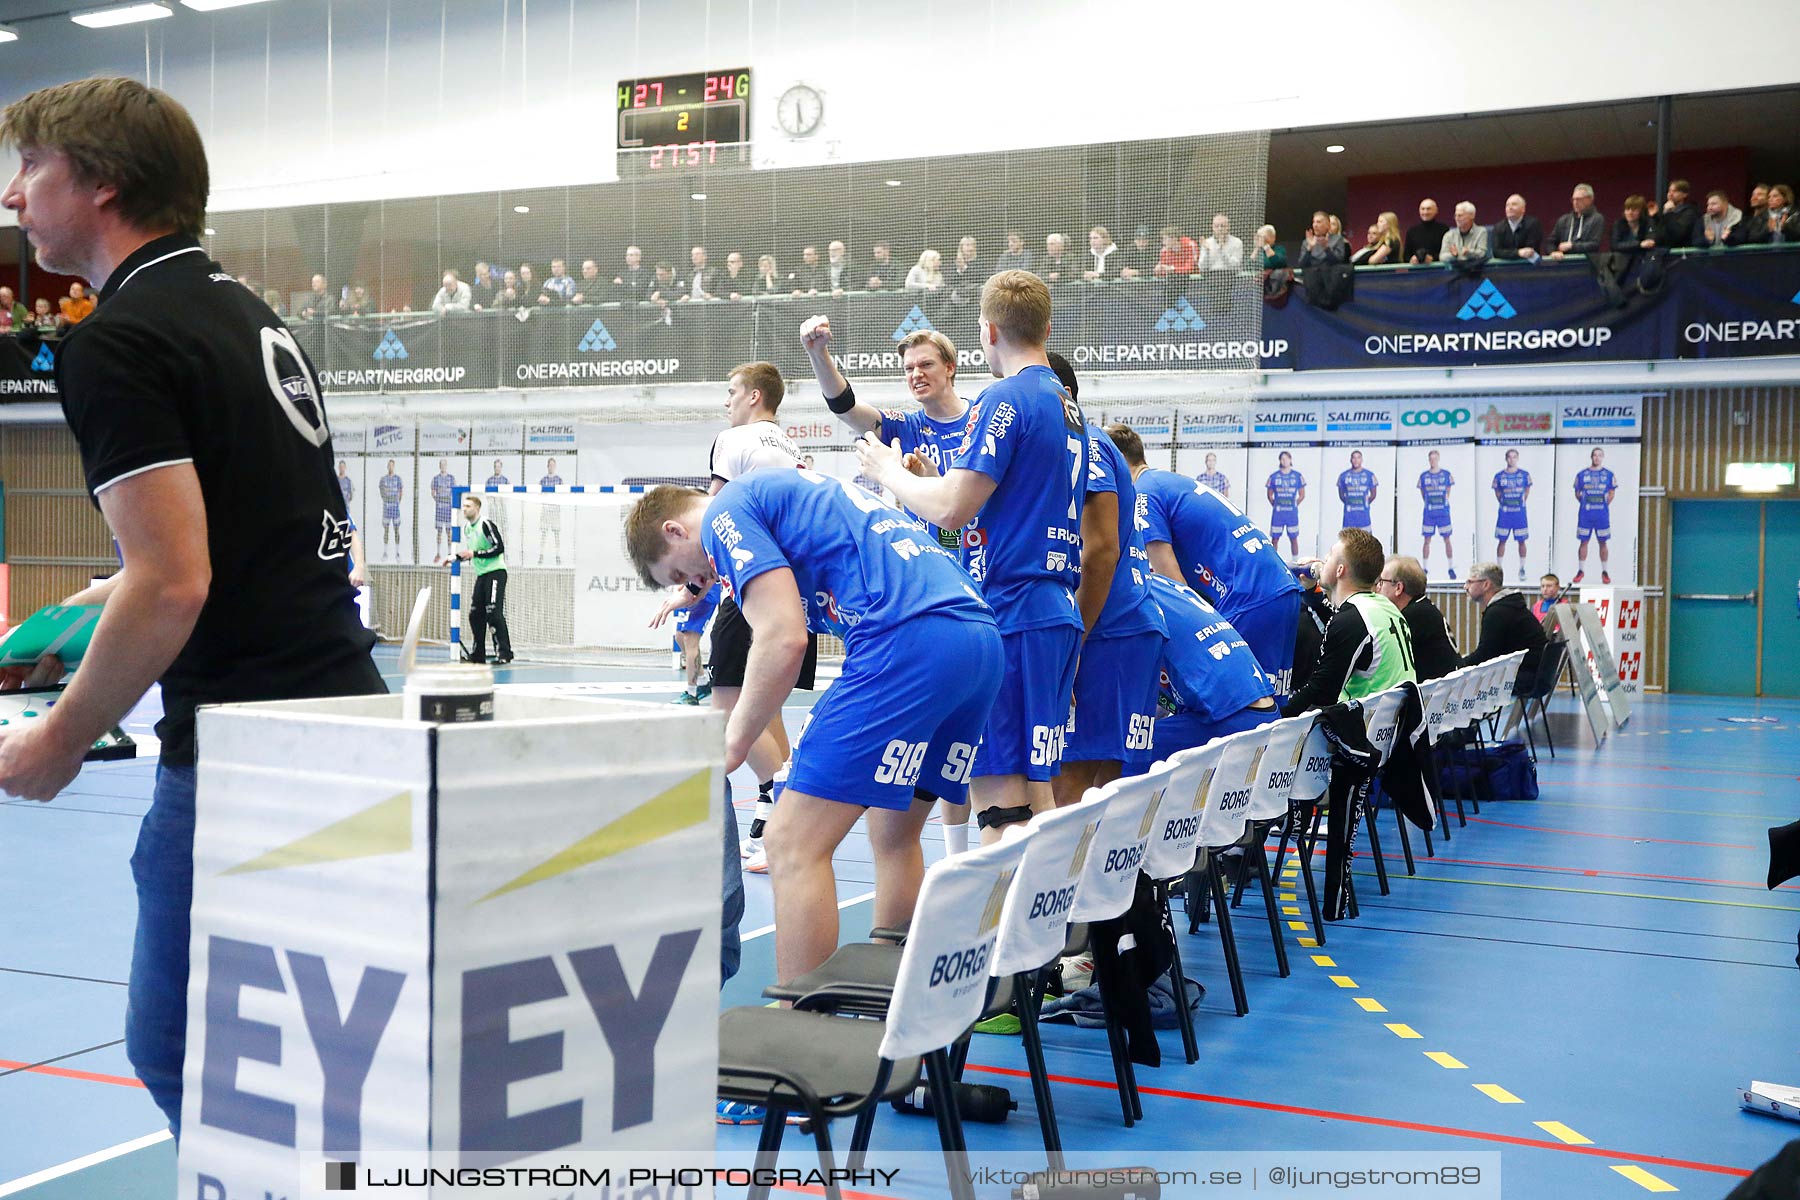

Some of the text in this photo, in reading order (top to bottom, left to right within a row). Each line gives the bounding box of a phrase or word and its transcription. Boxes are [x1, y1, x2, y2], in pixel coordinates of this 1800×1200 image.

[617, 87, 630, 108] H
[634, 83, 663, 108] 27
[704, 75, 734, 101] 24
[735, 74, 749, 97] G
[677, 112, 689, 131] 2
[1073, 340, 1289, 363] ONEPARTNERGROUP
[1365, 327, 1612, 355] ONEPARTNERGROUP
[318, 366, 465, 386] ONEPARTNERGROUP
[516, 358, 680, 379] ONEPARTNERGROUP
[987, 401, 1011, 435] INTER
[995, 405, 1017, 439] SPORT
[1254, 412, 1318, 423] SALMING
[1327, 411, 1392, 422] SALMING
[1401, 408, 1471, 428] coop
[200, 935, 408, 1166] EY
[458, 927, 703, 1172] EY
